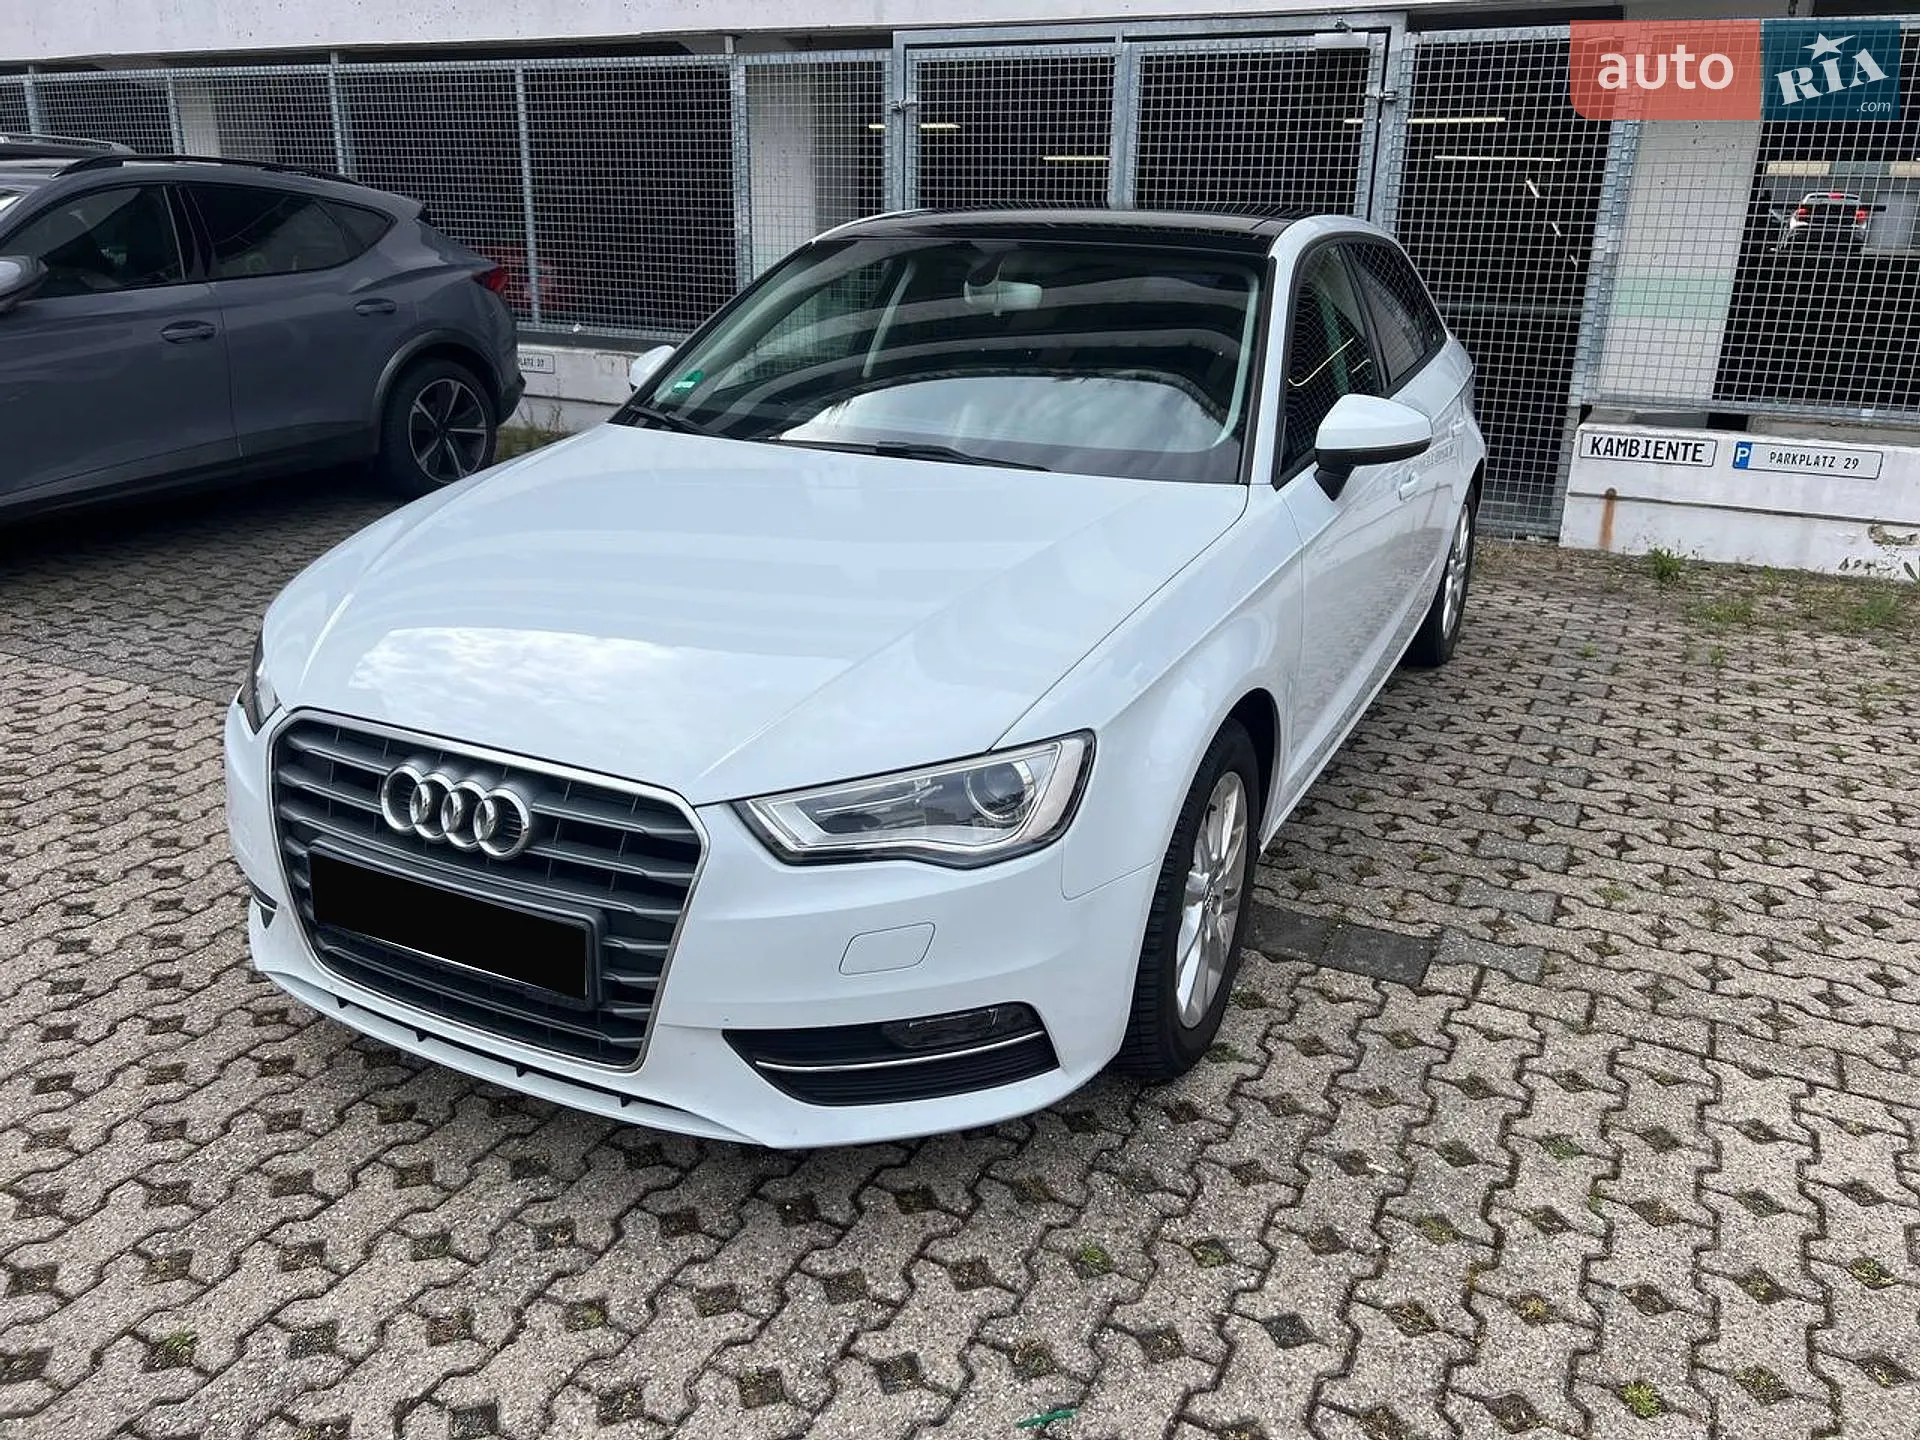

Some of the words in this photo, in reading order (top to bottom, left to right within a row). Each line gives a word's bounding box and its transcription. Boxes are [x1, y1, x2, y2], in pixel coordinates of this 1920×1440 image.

[1590, 436, 1705, 463] KAMBIENTE
[1735, 446, 1750, 463] P
[1768, 451, 1837, 469] PARKPLATZ
[1843, 457, 1860, 470] 29
